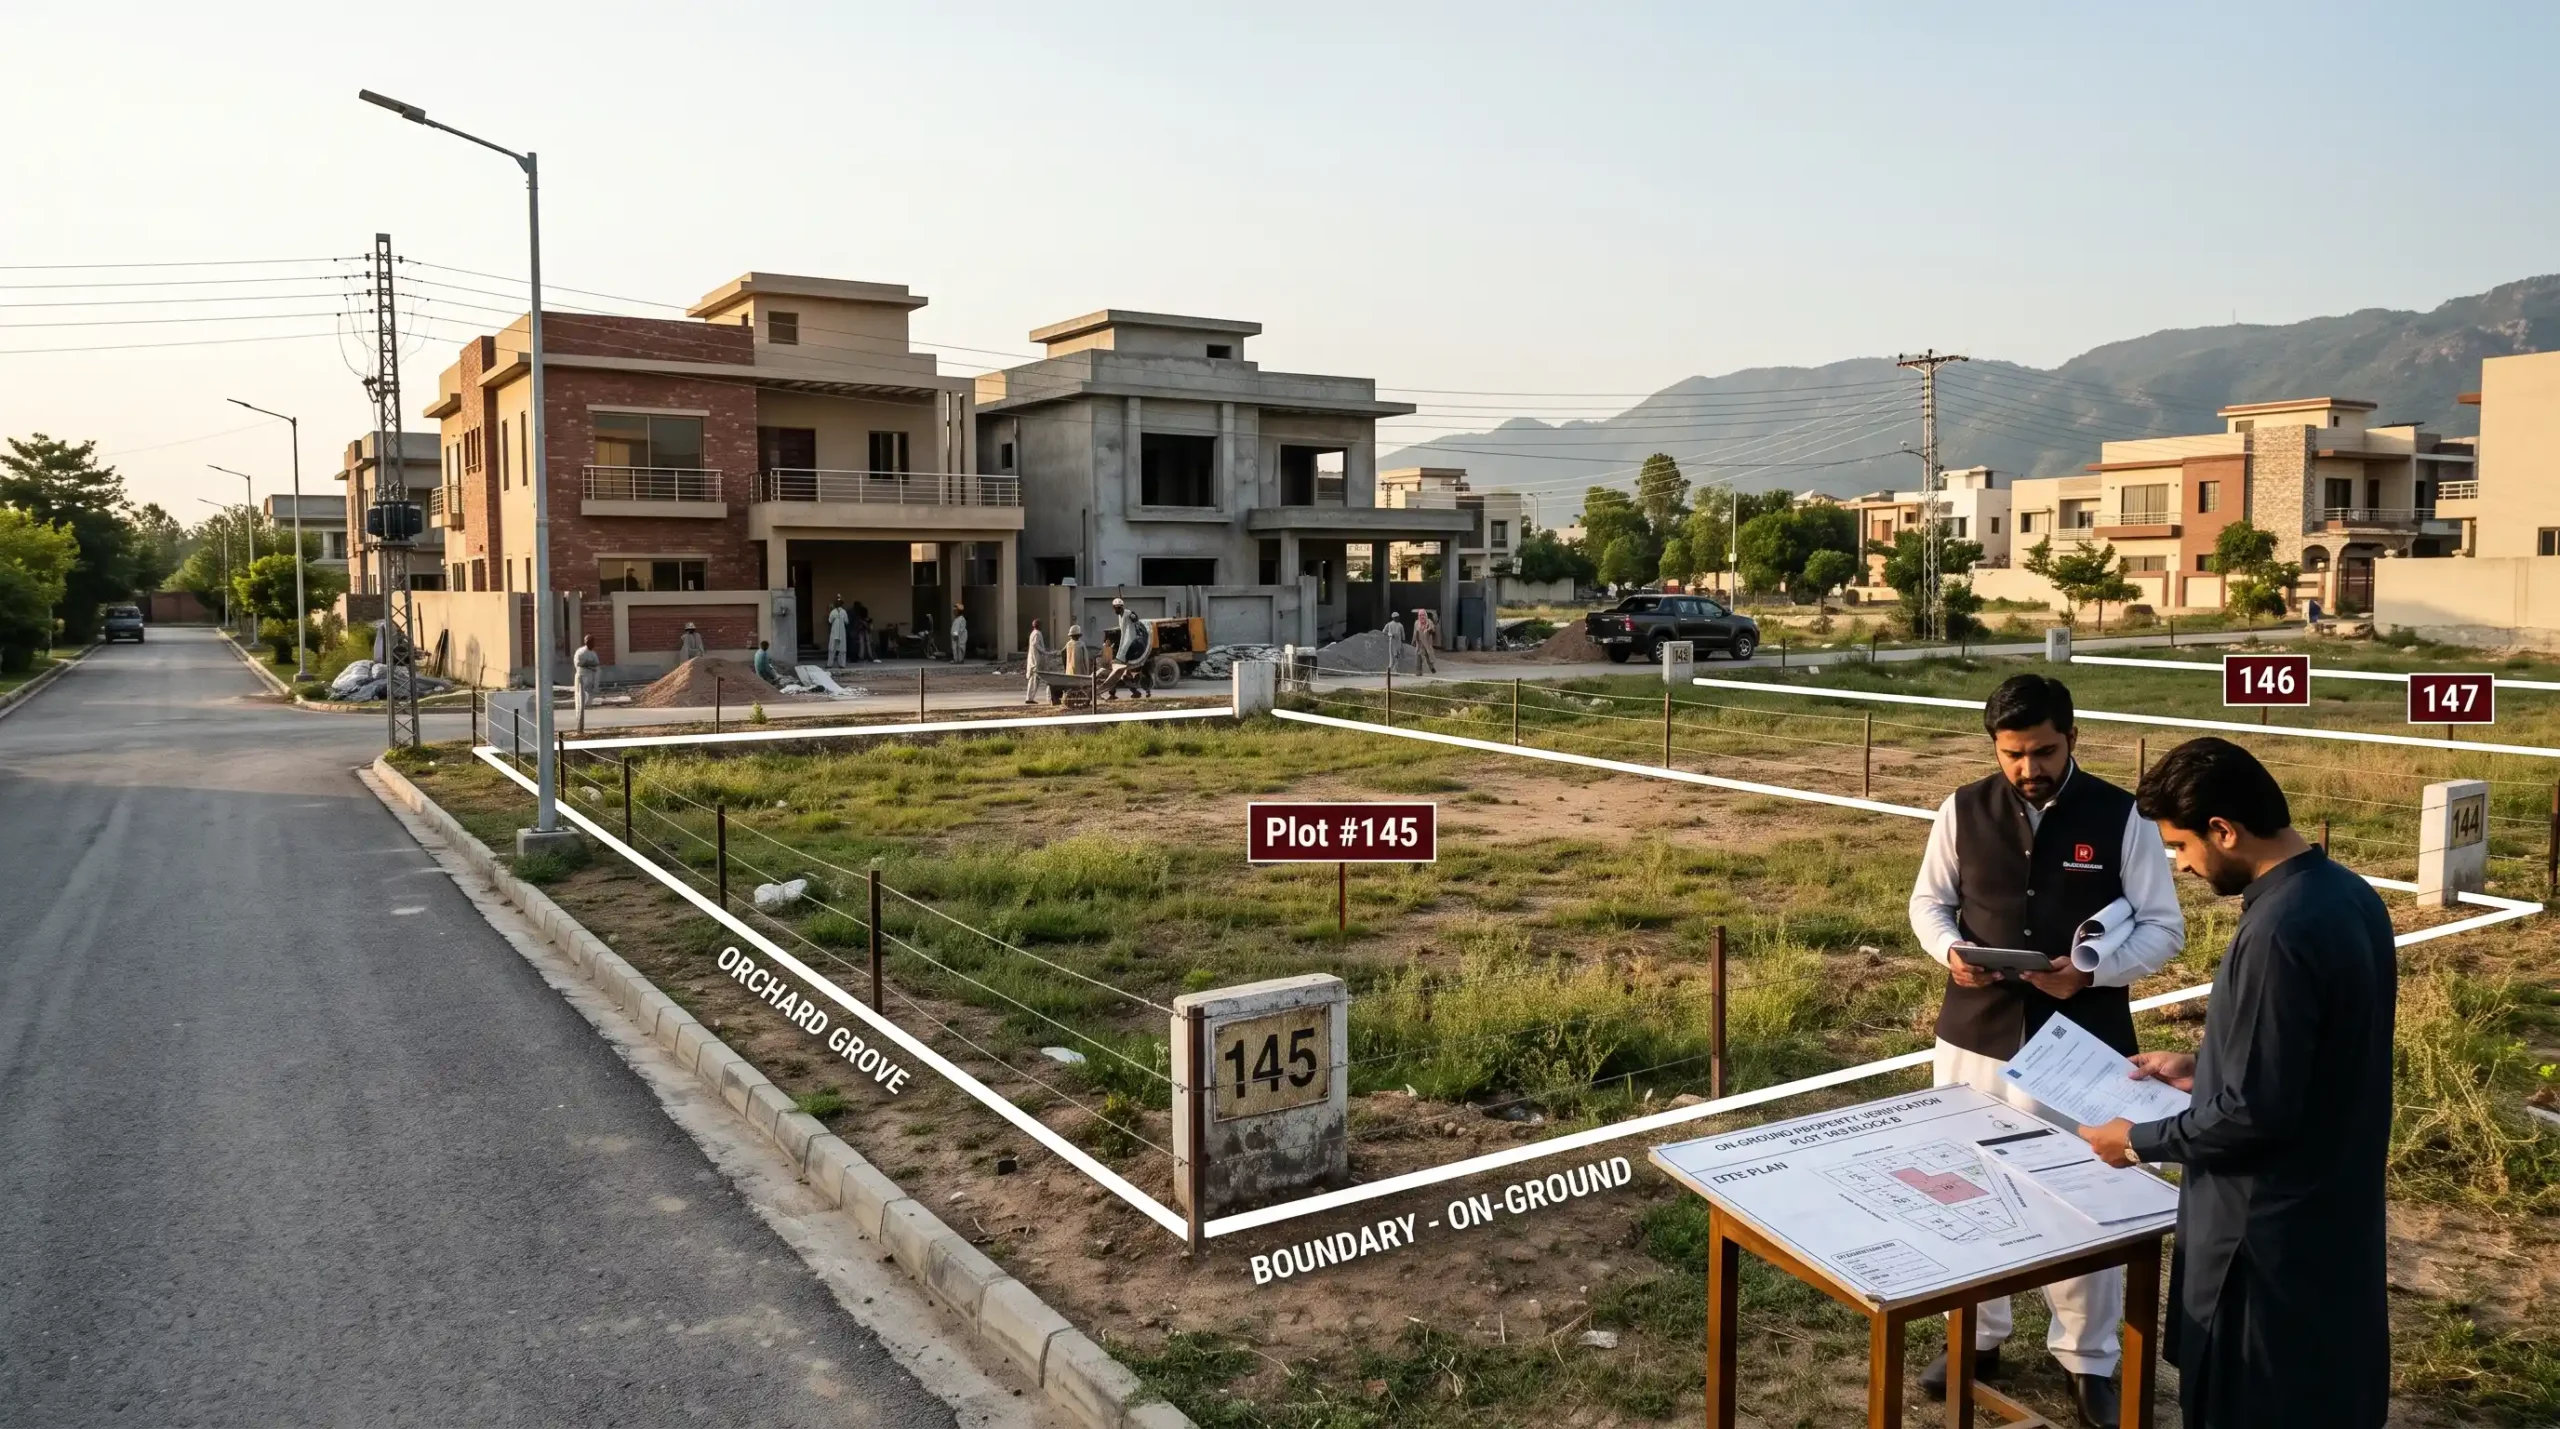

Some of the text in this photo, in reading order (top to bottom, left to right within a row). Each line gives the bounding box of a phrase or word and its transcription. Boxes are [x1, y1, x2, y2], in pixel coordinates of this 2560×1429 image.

[2239, 665, 2296, 695] 146
[2423, 684, 2479, 713] 147
[1266, 816, 1418, 848] Plot #145
[2453, 804, 2480, 840] 144
[1224, 1027, 1317, 1099] 145
[1747, 1161, 1789, 1177] PLAN
